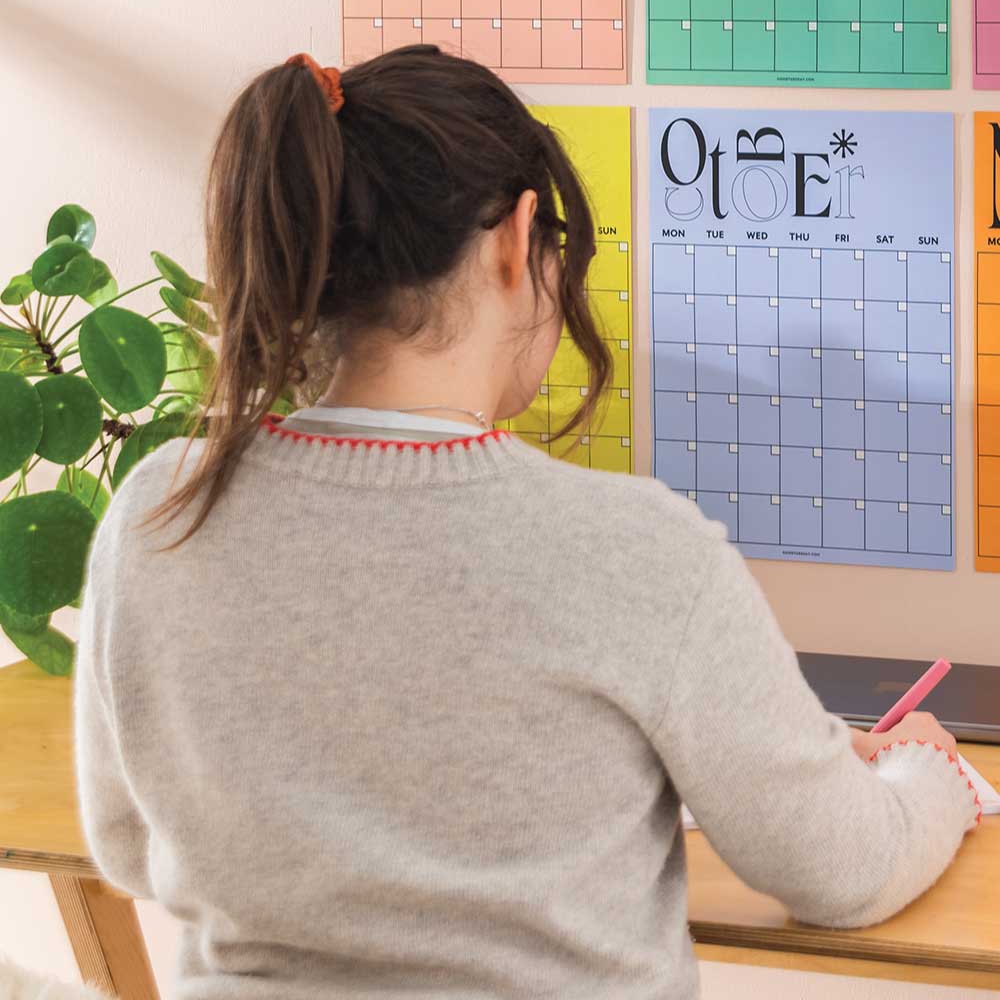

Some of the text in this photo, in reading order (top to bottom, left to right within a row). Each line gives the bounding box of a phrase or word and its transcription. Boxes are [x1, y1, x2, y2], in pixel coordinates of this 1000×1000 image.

[598, 226, 617, 235] SUN
[662, 228, 939, 245] MON TUE WED THU FRI SAT SUN
